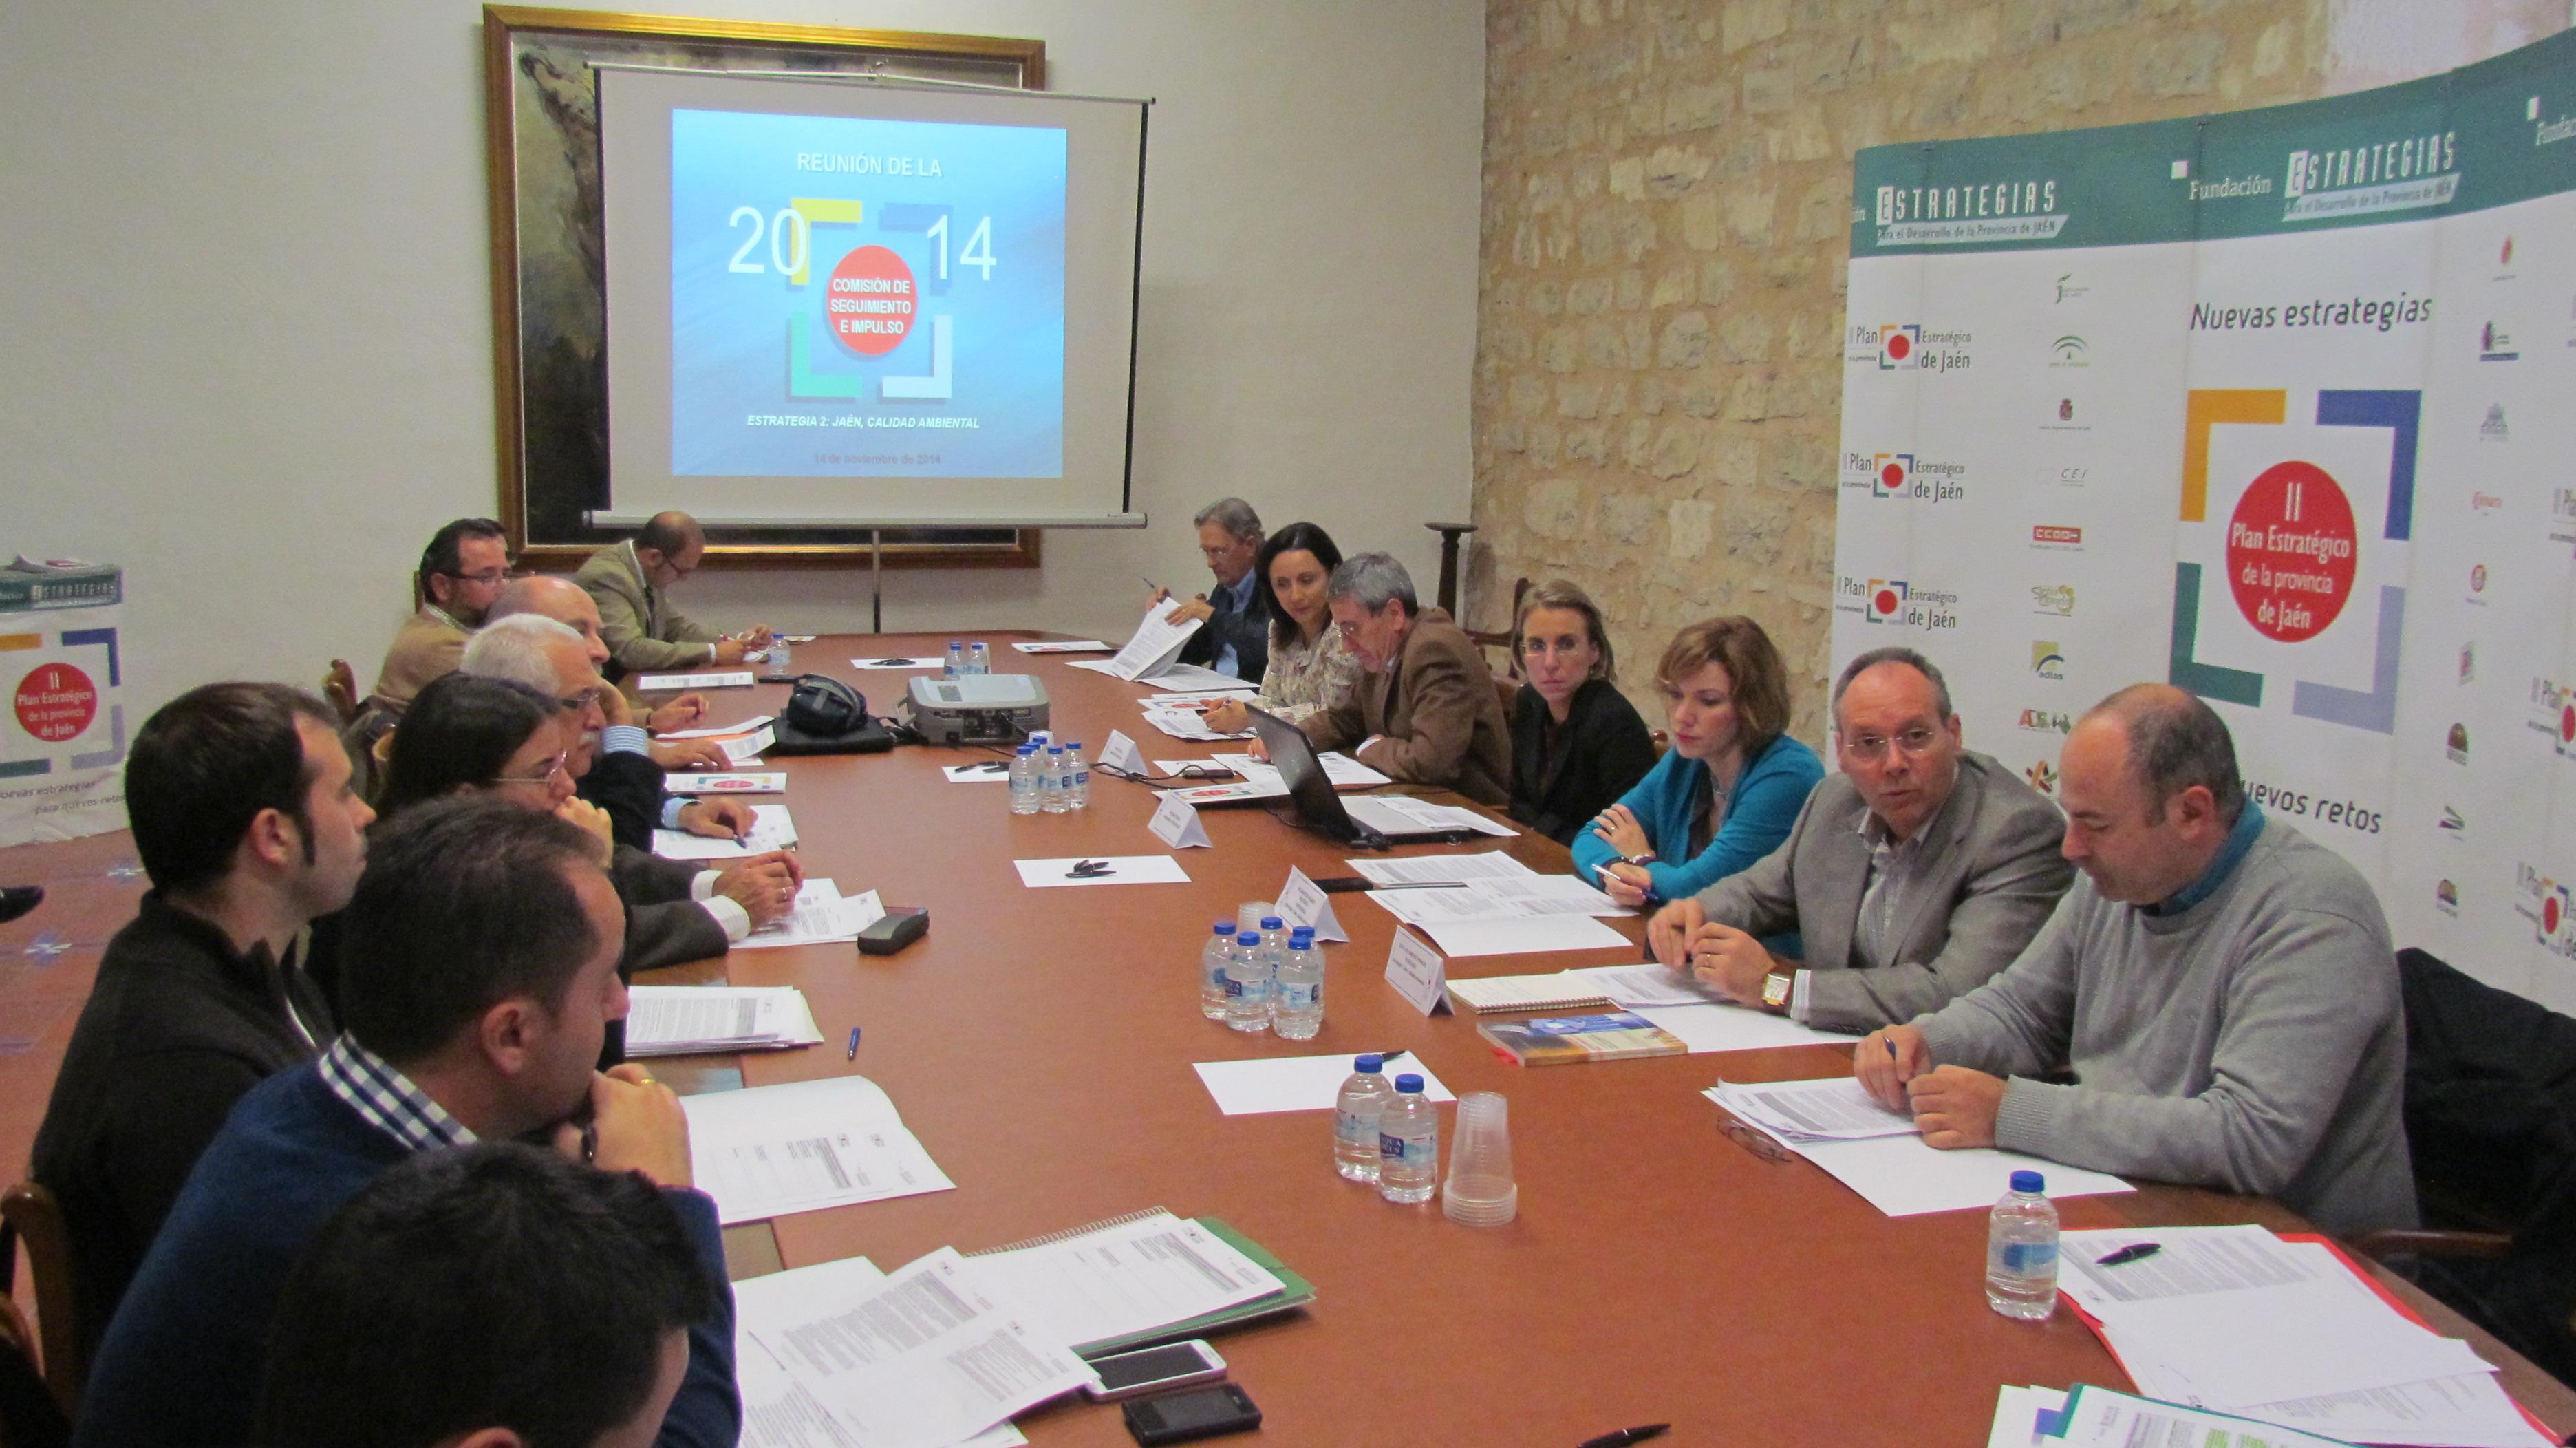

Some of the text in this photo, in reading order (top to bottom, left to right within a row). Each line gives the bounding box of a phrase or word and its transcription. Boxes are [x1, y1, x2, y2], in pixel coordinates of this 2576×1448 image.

[797, 152, 943, 177] REUNIÓN DE LA
[2189, 131, 2455, 201] Fundación ESTRATEGIAS
[1876, 180, 2057, 225] ESTRATEGIAS
[728, 206, 998, 281] 20 14
[833, 277, 910, 294] COMISIÓN DE
[830, 299, 912, 315] SEGUIMIENTO
[2189, 292, 2433, 332] Nuevas estrategias
[840, 319, 904, 334] E IMPULSO
[1856, 326, 1878, 344] Plan
[1922, 330, 1972, 346] Estratégico
[1921, 350, 1971, 373] de Jaén
[747, 414, 980, 429] ESTRATEGIA 2: JAÉN, CALIDAD AMBIENTAL
[1849, 452, 1872, 471] Plan
[1915, 460, 1965, 478] Estratégico
[1915, 480, 1963, 503] de Jaén
[2284, 482, 2301, 521] II
[2232, 522, 2350, 564] Plan Estratégico
[1843, 577, 1865, 596] Plan
[2242, 562, 2333, 594] de la provincia
[1909, 588, 1958, 606] Estratégico
[1908, 607, 1956, 630] de Jaén
[2257, 598, 2311, 632] de Jaén
[2315, 800, 2383, 834] retos
